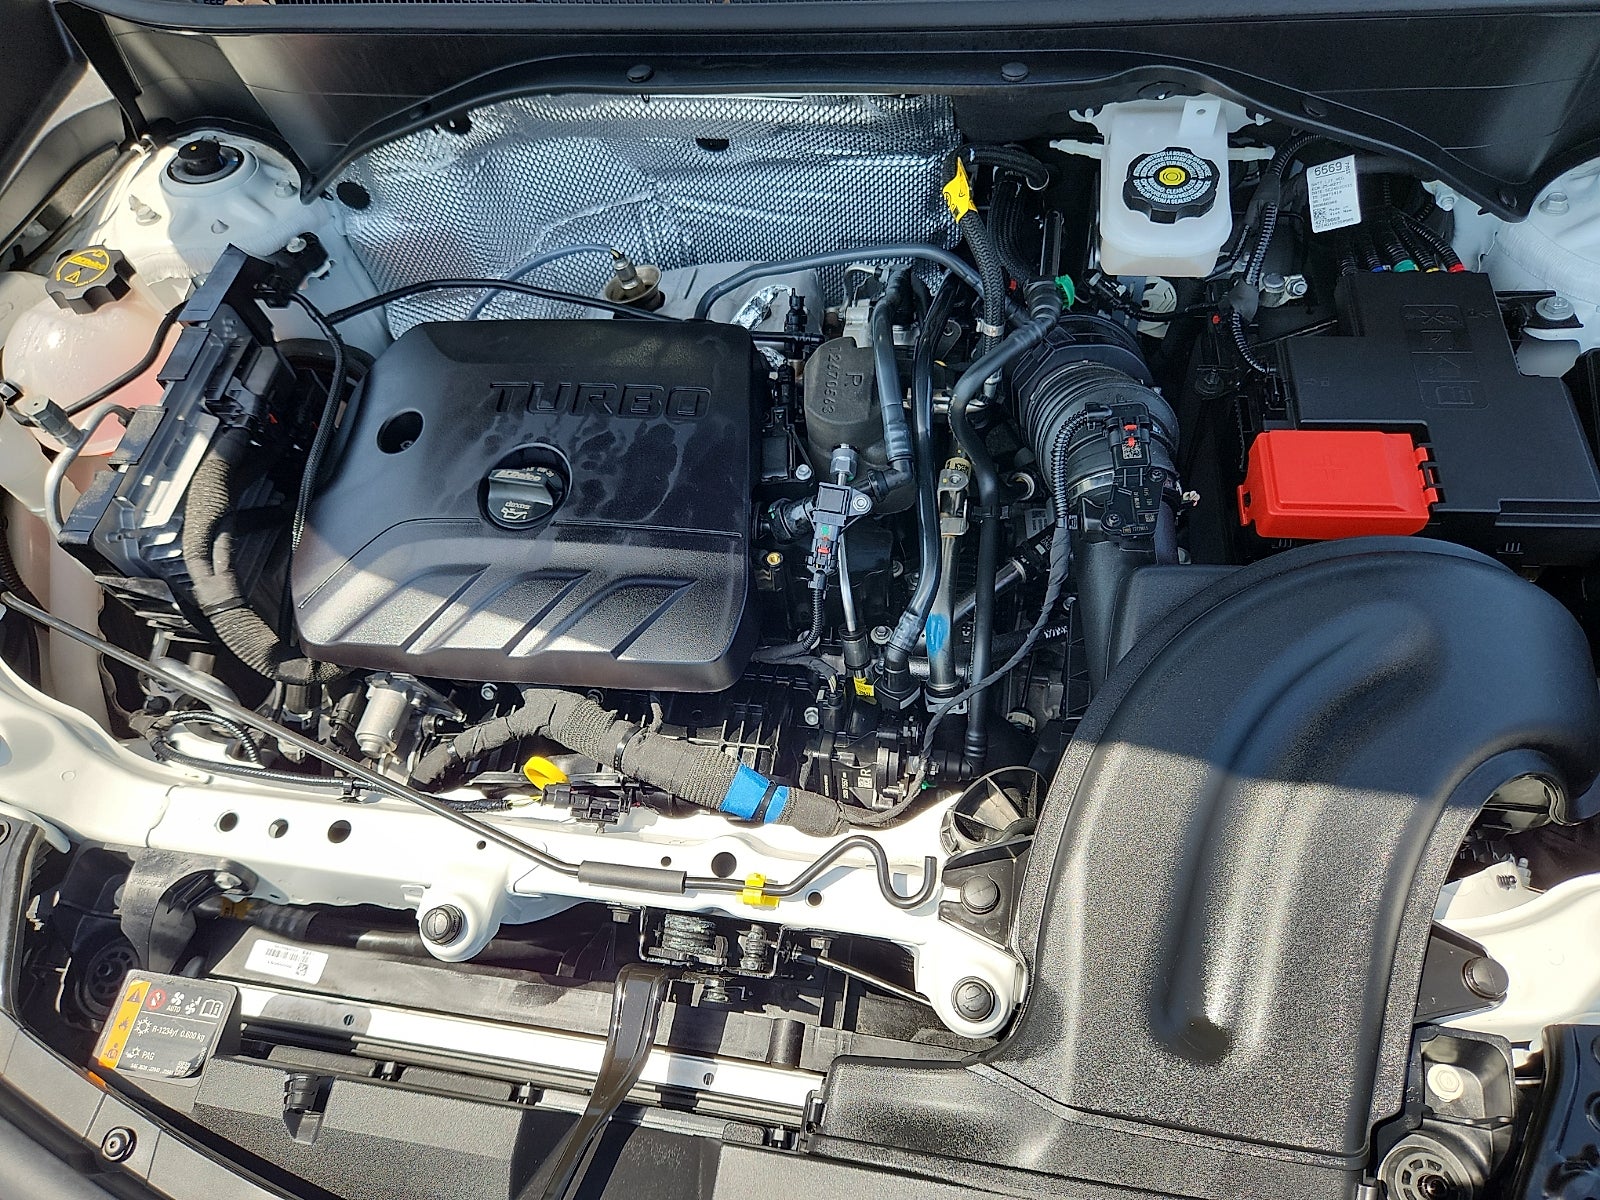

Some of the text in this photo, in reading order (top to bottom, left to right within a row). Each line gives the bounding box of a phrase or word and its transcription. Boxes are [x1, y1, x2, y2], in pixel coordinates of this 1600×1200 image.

[1314, 161, 1343, 177] 6669
[490, 381, 712, 420] TURBO
[494, 469, 542, 481] ACDelco
[860, 768, 872, 777] R
[166, 1005, 181, 1013] AUTO
[196, 1032, 205, 1042] kg
[141, 1051, 155, 1060] PAG
